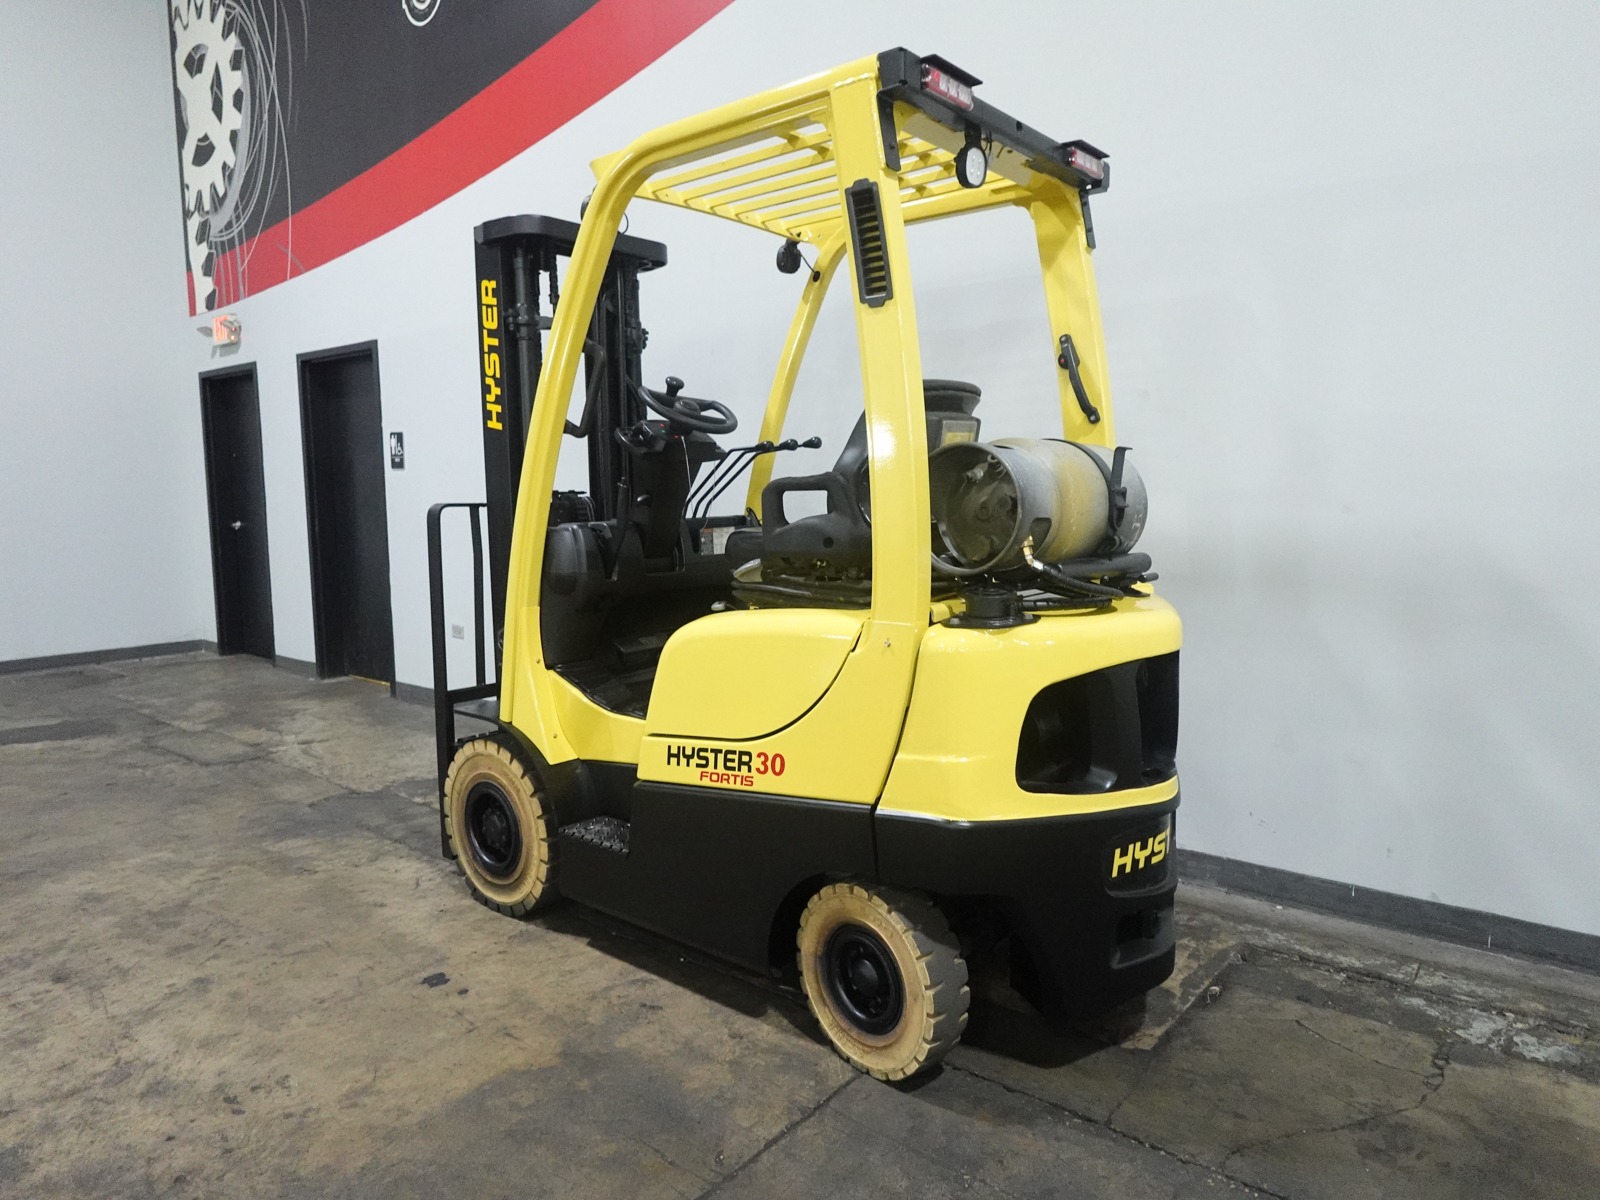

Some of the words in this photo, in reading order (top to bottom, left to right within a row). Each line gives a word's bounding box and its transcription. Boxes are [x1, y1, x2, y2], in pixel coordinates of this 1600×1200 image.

[481, 279, 503, 431] HYSTER
[667, 745, 753, 773] HYSTER
[755, 752, 786, 776] 30
[699, 771, 754, 787] FORTIS
